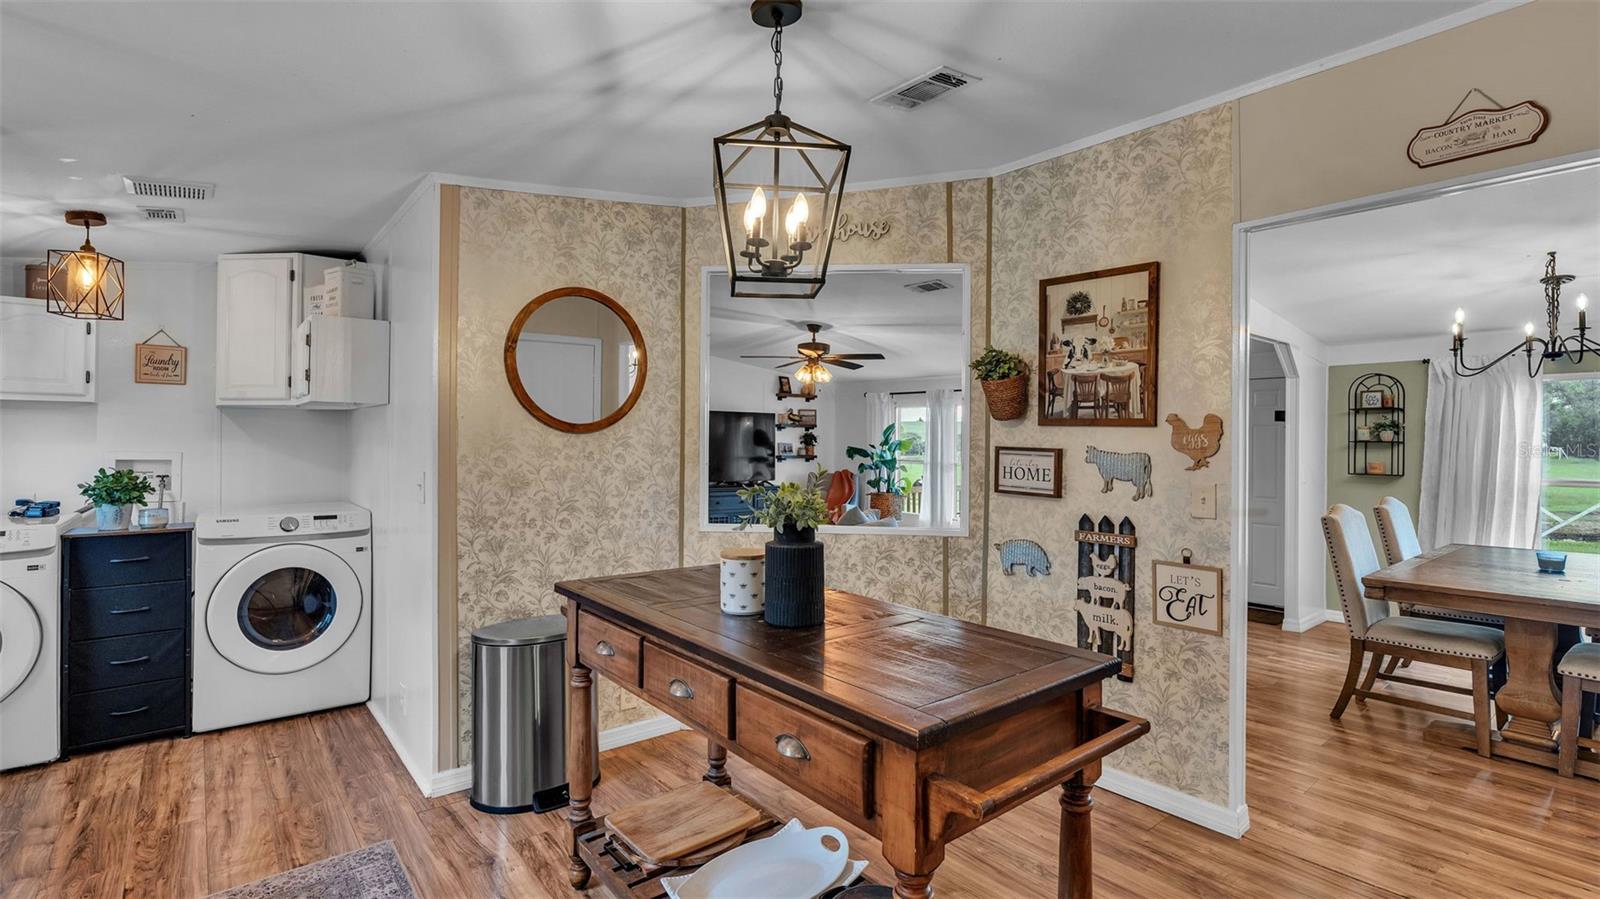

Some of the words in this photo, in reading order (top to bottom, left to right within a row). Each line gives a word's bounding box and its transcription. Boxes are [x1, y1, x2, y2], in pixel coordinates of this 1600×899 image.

[1433, 123, 1473, 139] COUNTRY
[1474, 112, 1514, 129] MARKET
[1492, 128, 1517, 139] HAM
[1425, 143, 1453, 155] BACON
[143, 351, 179, 373] Laundry
[1003, 466, 1052, 483] HOME
[1080, 532, 1131, 545] FARMERS
[1170, 574, 1201, 587] LET'S
[1093, 613, 1119, 626] milk.
